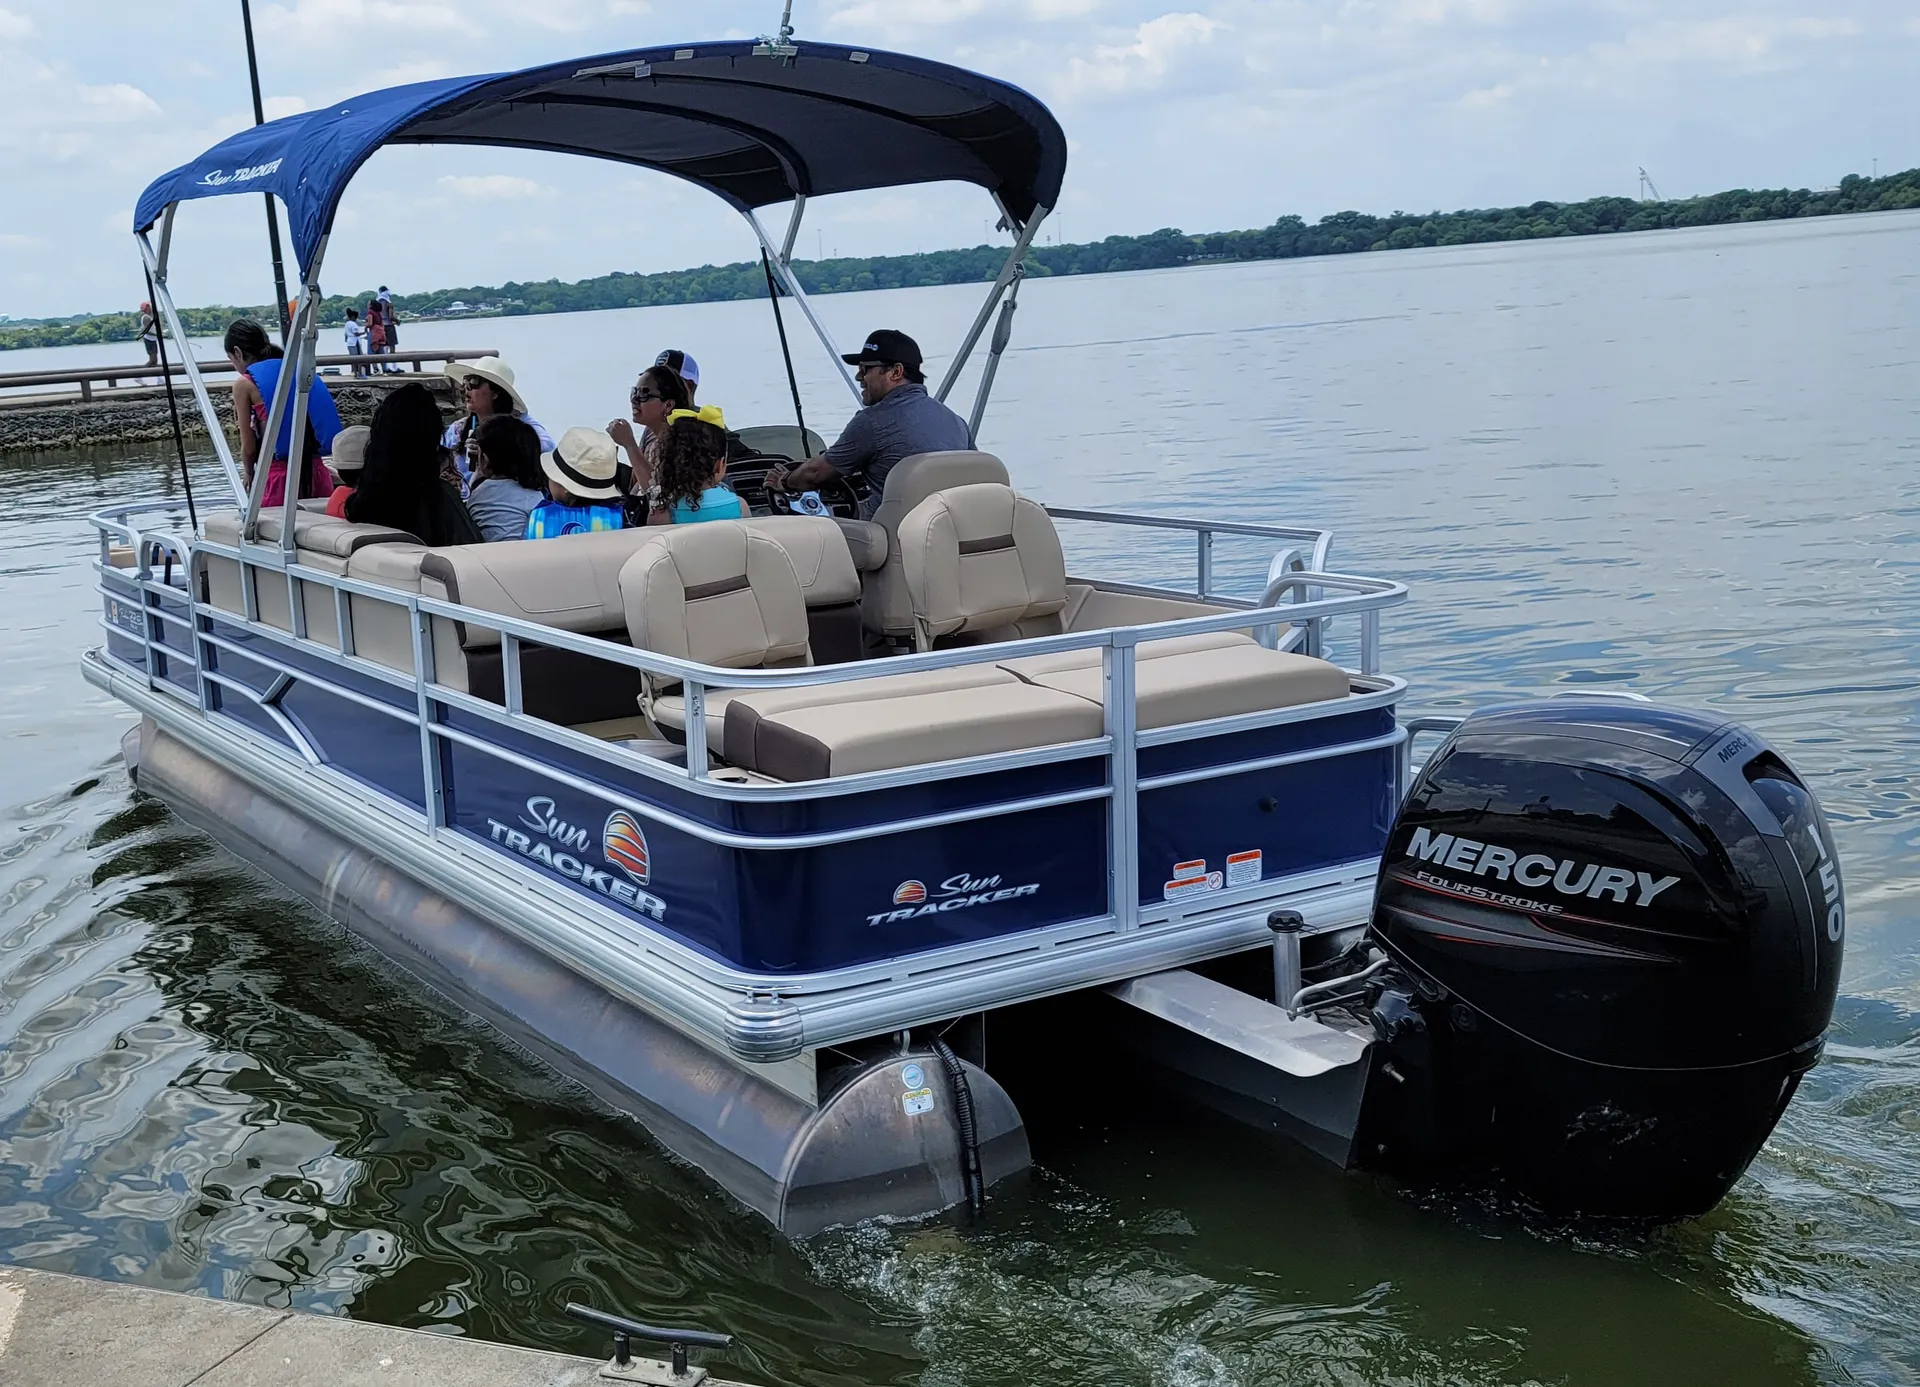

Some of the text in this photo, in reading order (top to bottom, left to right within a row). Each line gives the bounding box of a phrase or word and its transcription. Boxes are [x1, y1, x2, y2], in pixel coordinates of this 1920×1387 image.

[195, 169, 232, 186] Sun
[1716, 736, 1749, 764] MERC
[517, 795, 591, 853] Sun
[487, 817, 668, 922] TRACKER
[929, 872, 1003, 898] Sun
[1405, 826, 1681, 907] MERCURY
[1806, 823, 1844, 943] 150
[866, 883, 1041, 927] TRACKER
[1416, 870, 1564, 915] FOURSTROKE
